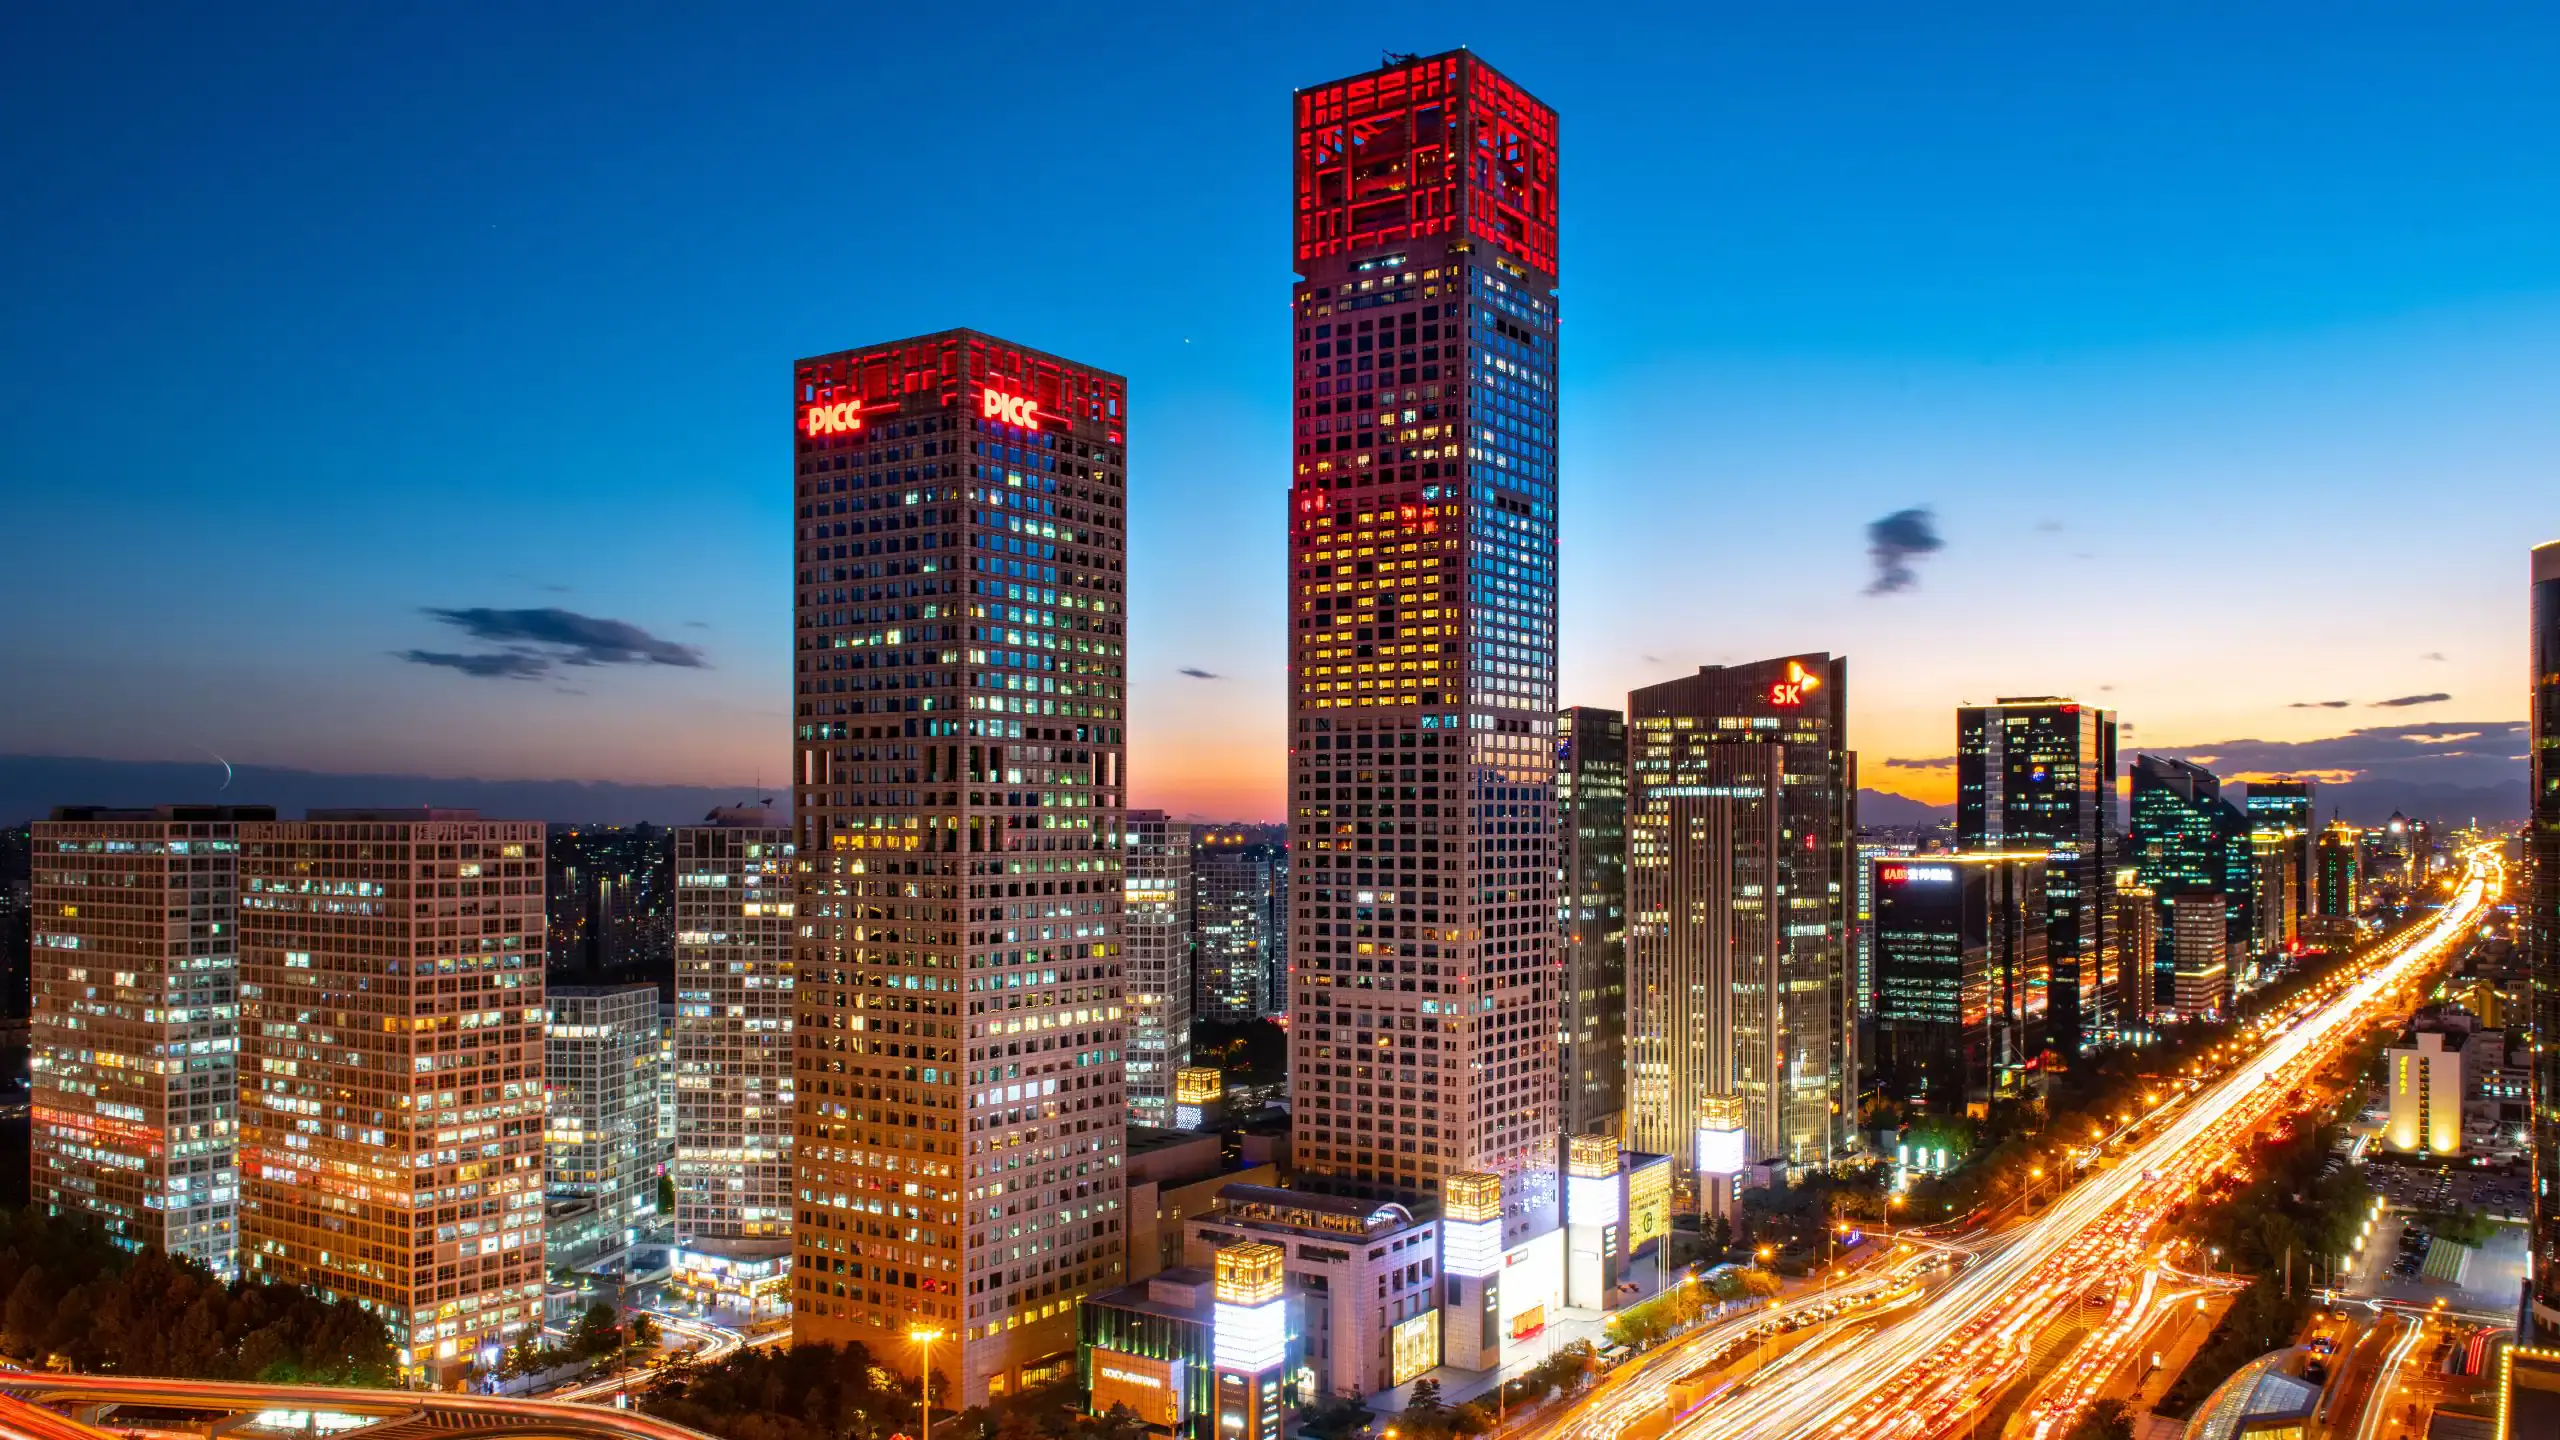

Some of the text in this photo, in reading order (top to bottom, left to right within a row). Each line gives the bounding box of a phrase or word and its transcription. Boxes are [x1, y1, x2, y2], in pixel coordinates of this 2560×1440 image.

[809, 400, 861, 436] PICC
[984, 388, 1038, 430] PICC
[1772, 684, 1800, 704] SK
